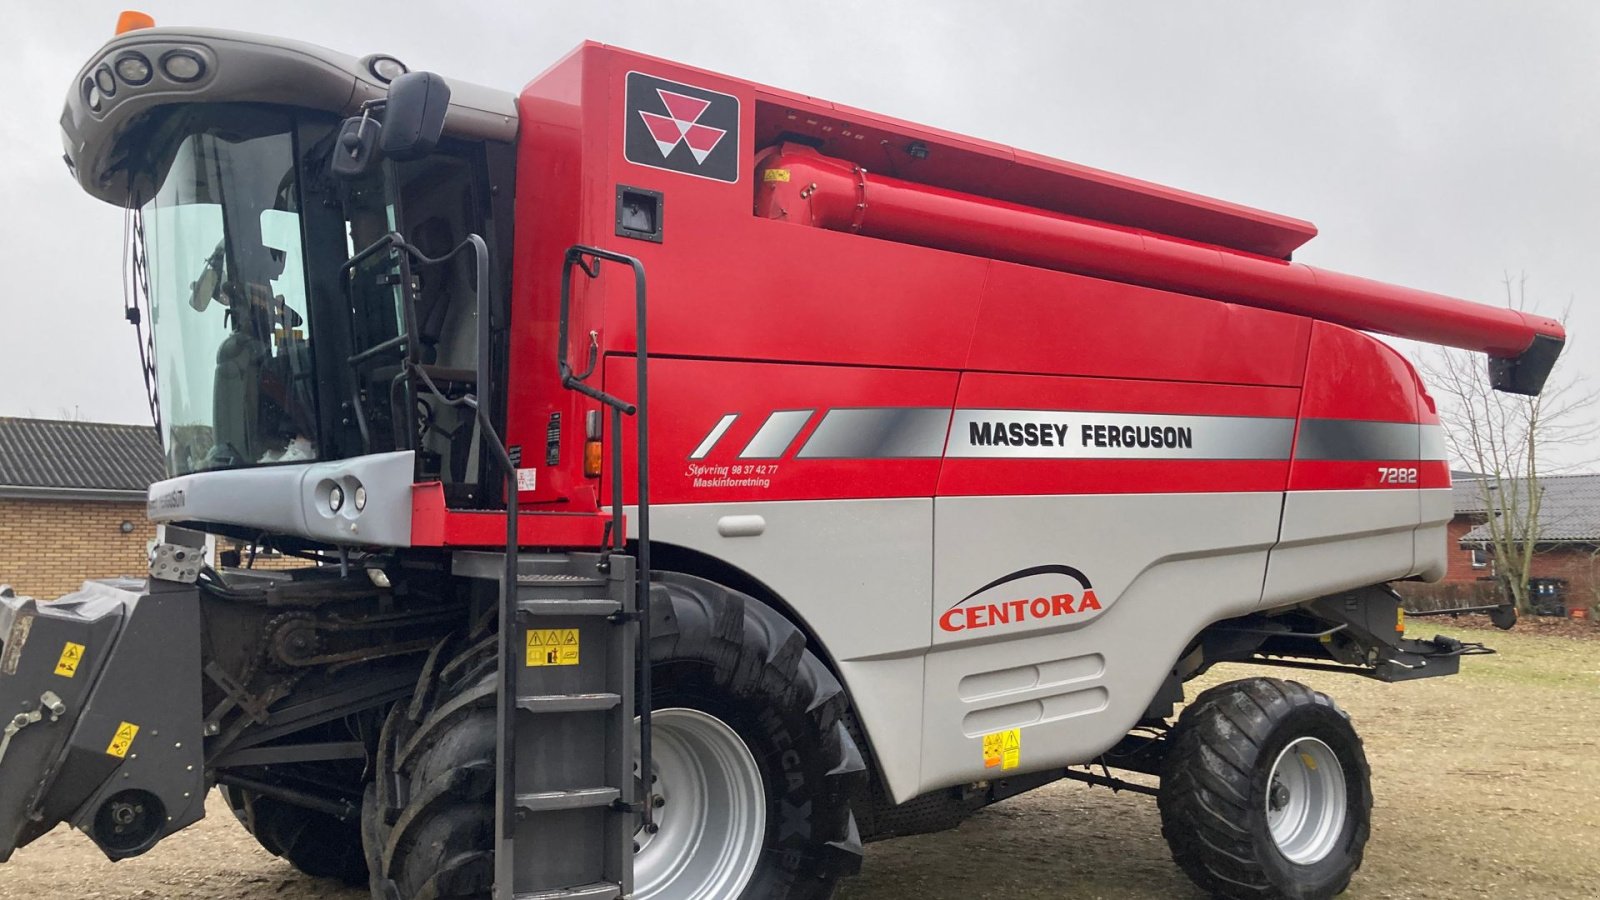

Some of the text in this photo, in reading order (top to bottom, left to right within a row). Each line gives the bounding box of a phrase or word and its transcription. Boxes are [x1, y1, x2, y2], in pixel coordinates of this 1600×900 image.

[969, 421, 1193, 449] MASSEY FERGUSON
[685, 463, 778, 479] Støvring 98 37 42 77
[1378, 467, 1417, 484] 7282
[693, 478, 770, 488] Maskinforretning
[939, 590, 1102, 632] CENTORA
